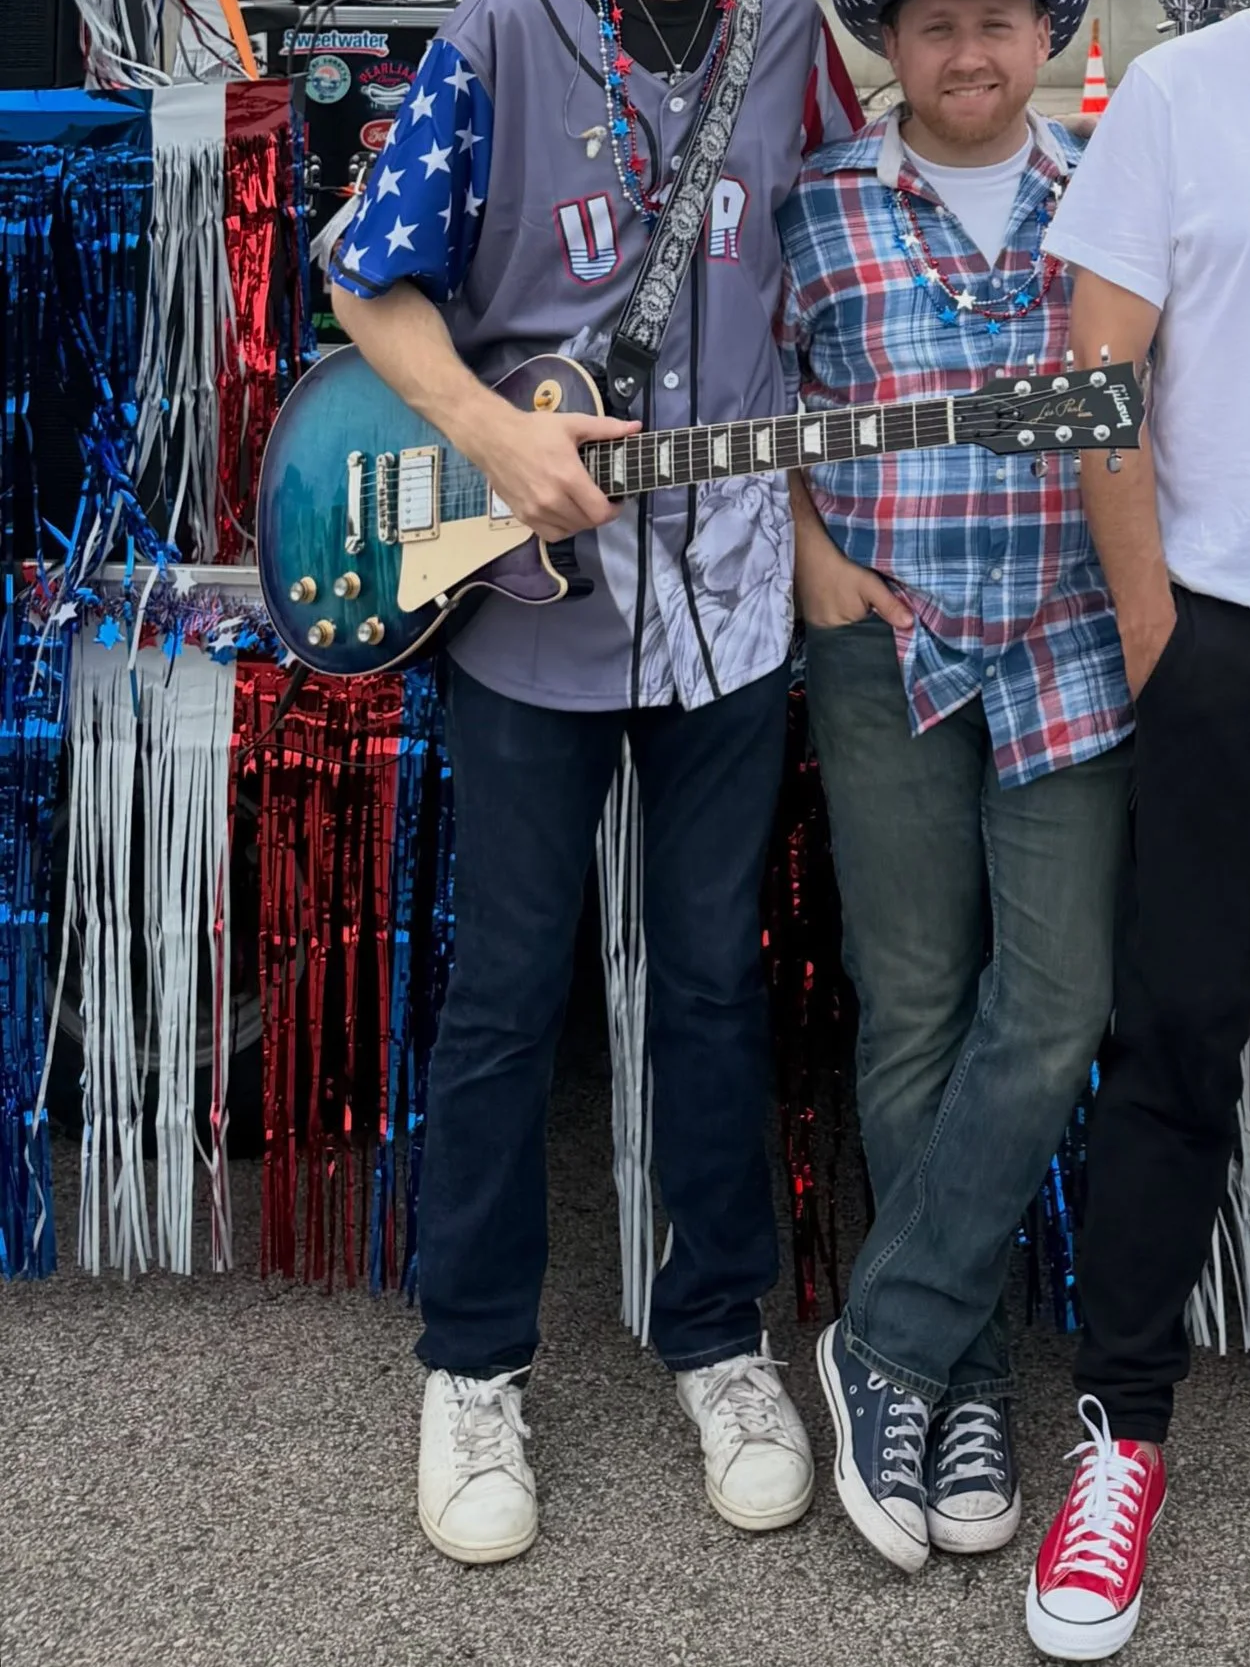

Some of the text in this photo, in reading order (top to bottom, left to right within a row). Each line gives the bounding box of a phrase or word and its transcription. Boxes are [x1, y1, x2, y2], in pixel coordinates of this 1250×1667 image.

[284, 29, 388, 49] Sweetwater
[1055, 397, 1087, 417] Paul
[1103, 384, 1133, 429] Gibson
